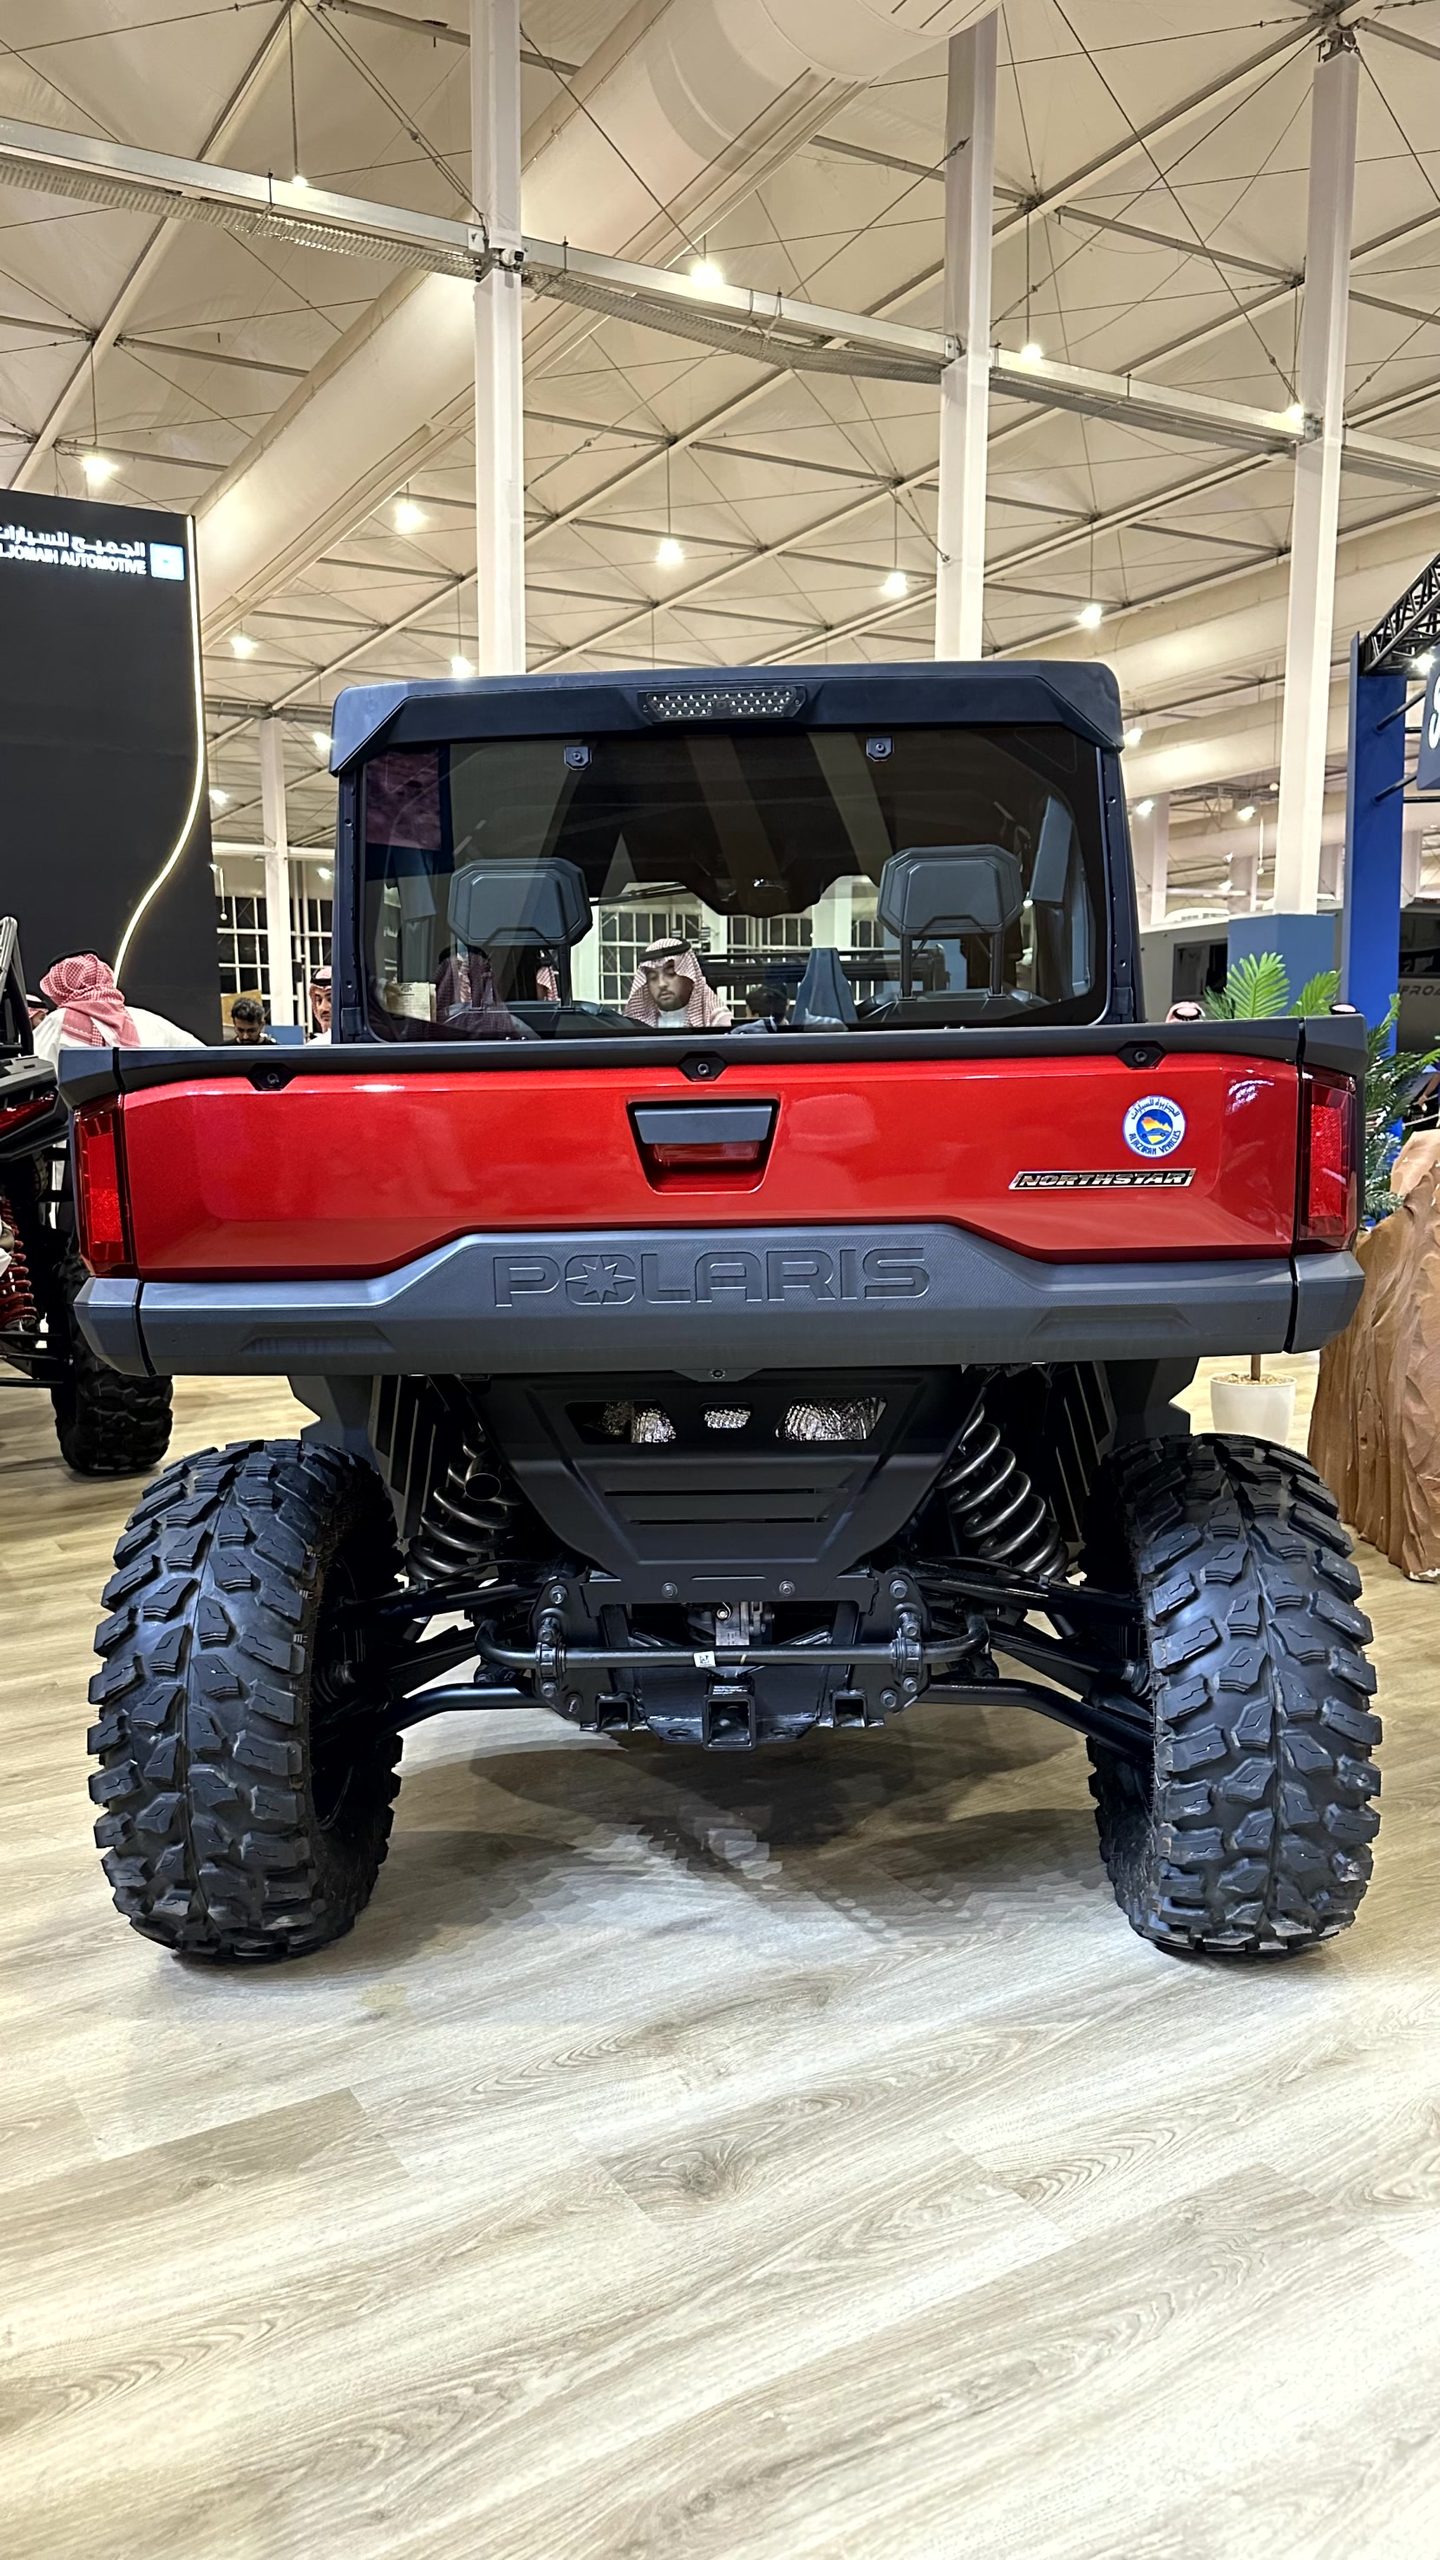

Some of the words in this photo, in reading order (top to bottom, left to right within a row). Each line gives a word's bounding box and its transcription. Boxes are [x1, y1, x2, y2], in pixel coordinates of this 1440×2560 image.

[60, 550, 147, 575] AUTOMOTIVE
[1158, 1129, 1182, 1154] VEHICLES
[1019, 1172, 1187, 1187] NORTHSTAR
[493, 1247, 931, 1307] POLARIS
